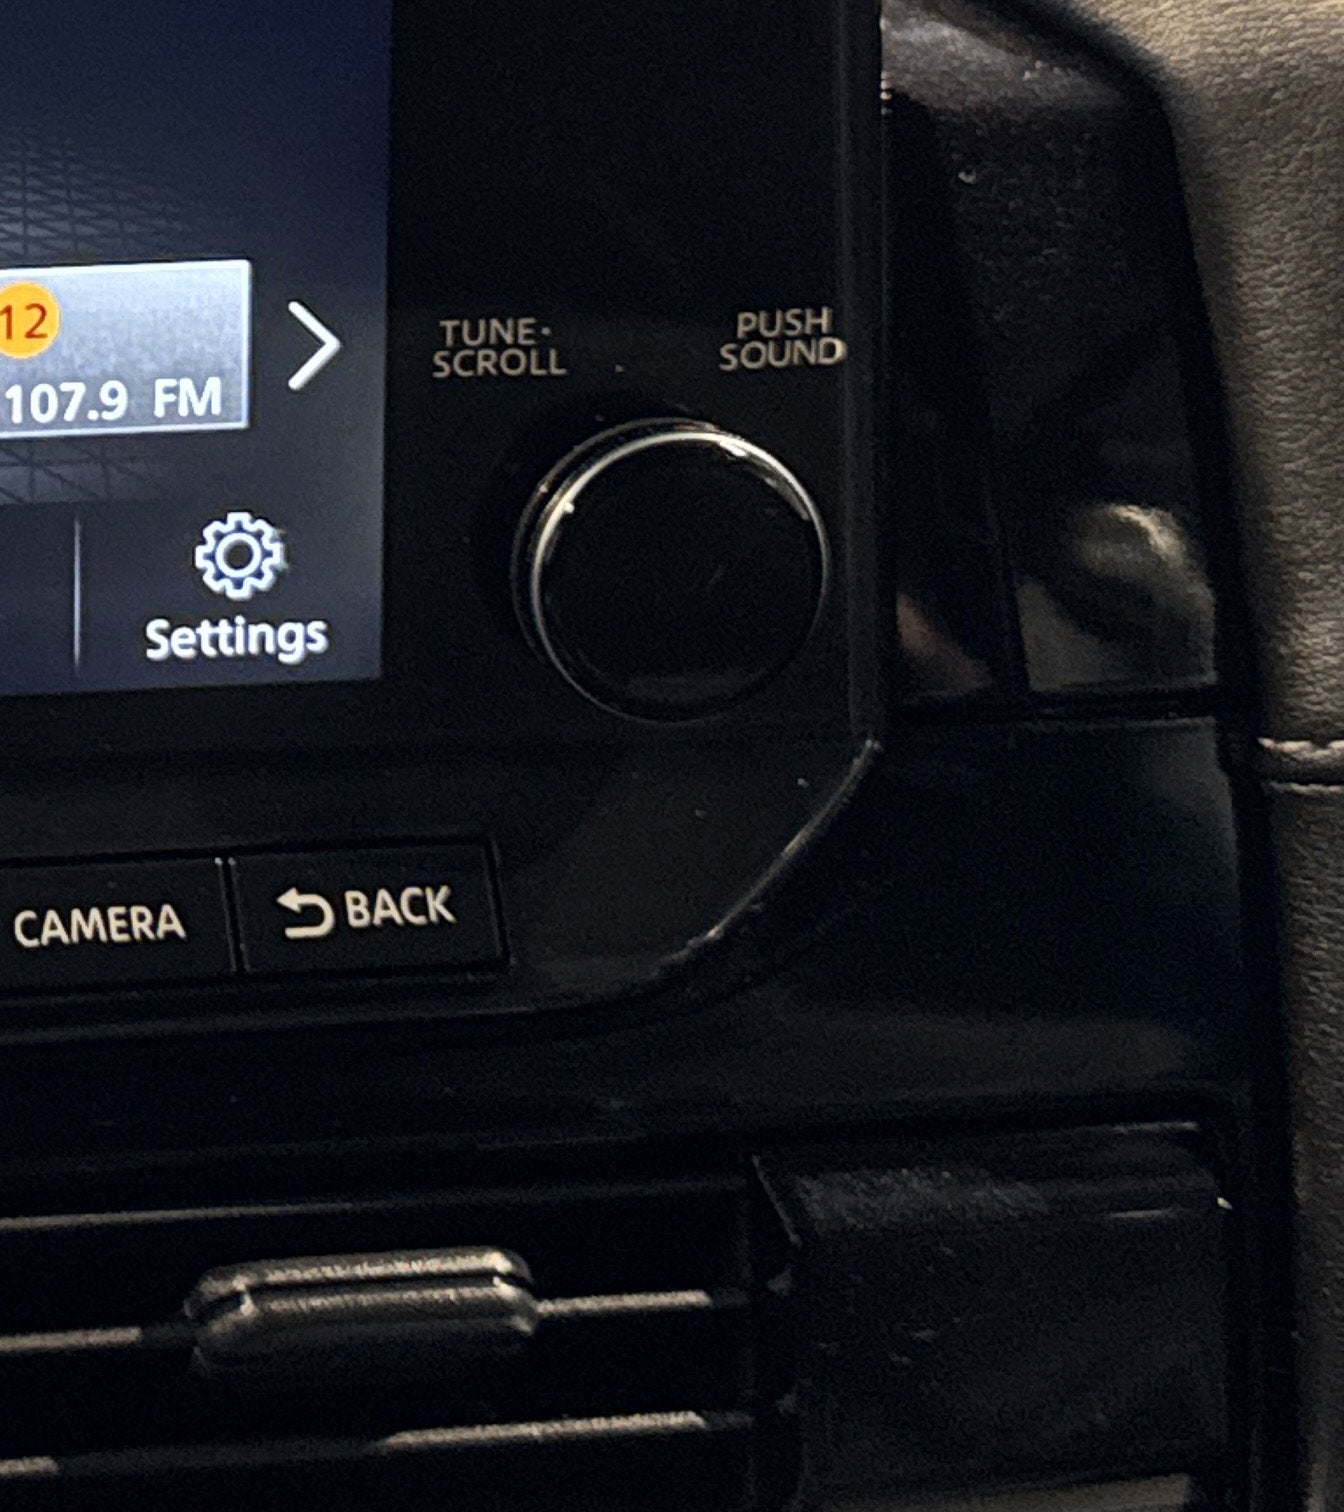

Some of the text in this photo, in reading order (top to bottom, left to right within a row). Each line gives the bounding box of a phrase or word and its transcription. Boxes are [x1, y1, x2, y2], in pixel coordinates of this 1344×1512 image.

[0, 302, 48, 340] 12
[737, 306, 833, 338] PUSH
[432, 348, 567, 378] SCROLL
[720, 337, 847, 371] SOUND
[4, 376, 222, 424] 107.9 FM
[146, 614, 328, 664] Settings
[14, 904, 186, 948] CAMERA
[344, 885, 455, 927] BACK
